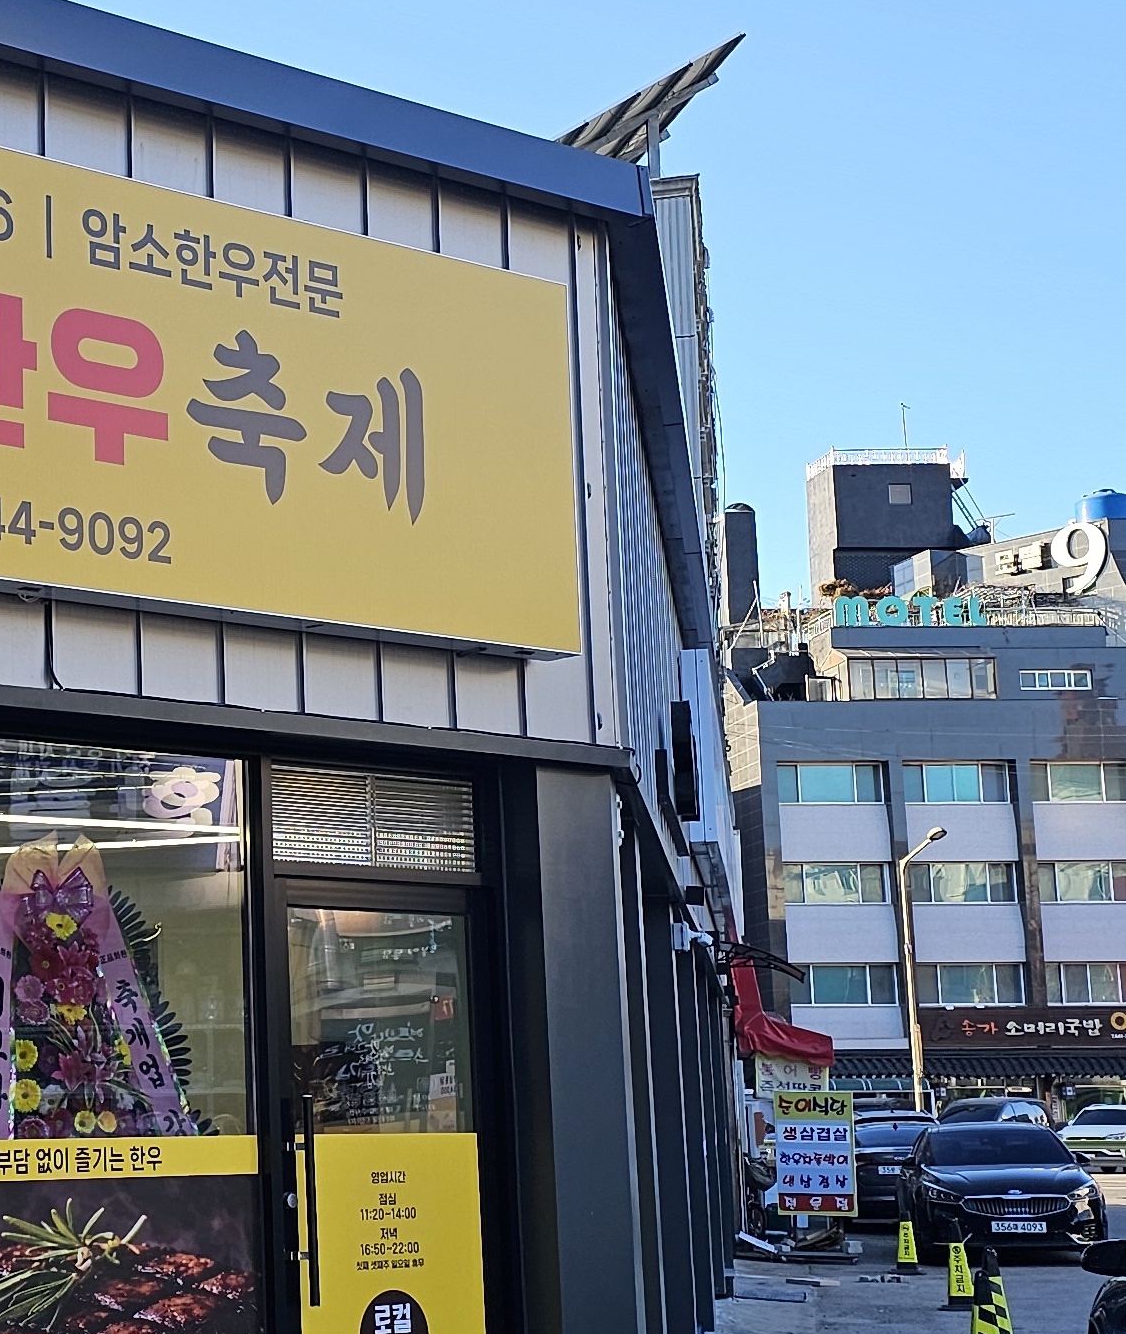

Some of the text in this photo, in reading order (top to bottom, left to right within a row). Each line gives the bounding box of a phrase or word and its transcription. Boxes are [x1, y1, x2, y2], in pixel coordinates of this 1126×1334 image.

[80, 207, 345, 321] 암소한우전문
[1051, 521, 1109, 595] 9
[835, 595, 987, 627] MOTEL
[1005, 1018, 1103, 1037] 소머리국밥
[783, 1126, 848, 1142] 생삼겹살
[36, 1147, 69, 1174] 없이
[75, 1146, 125, 1173] 즐기는
[130, 1145, 163, 1171] 한우
[371, 1171, 406, 1184] 영업시간
[378, 1193, 396, 1205] 점심
[380, 1227, 397, 1240] 저녁
[391, 1259, 410, 1269] 일요일
[953, 1255, 966, 1293] 주차금지
[374, 1303, 412, 1334] 로컬
